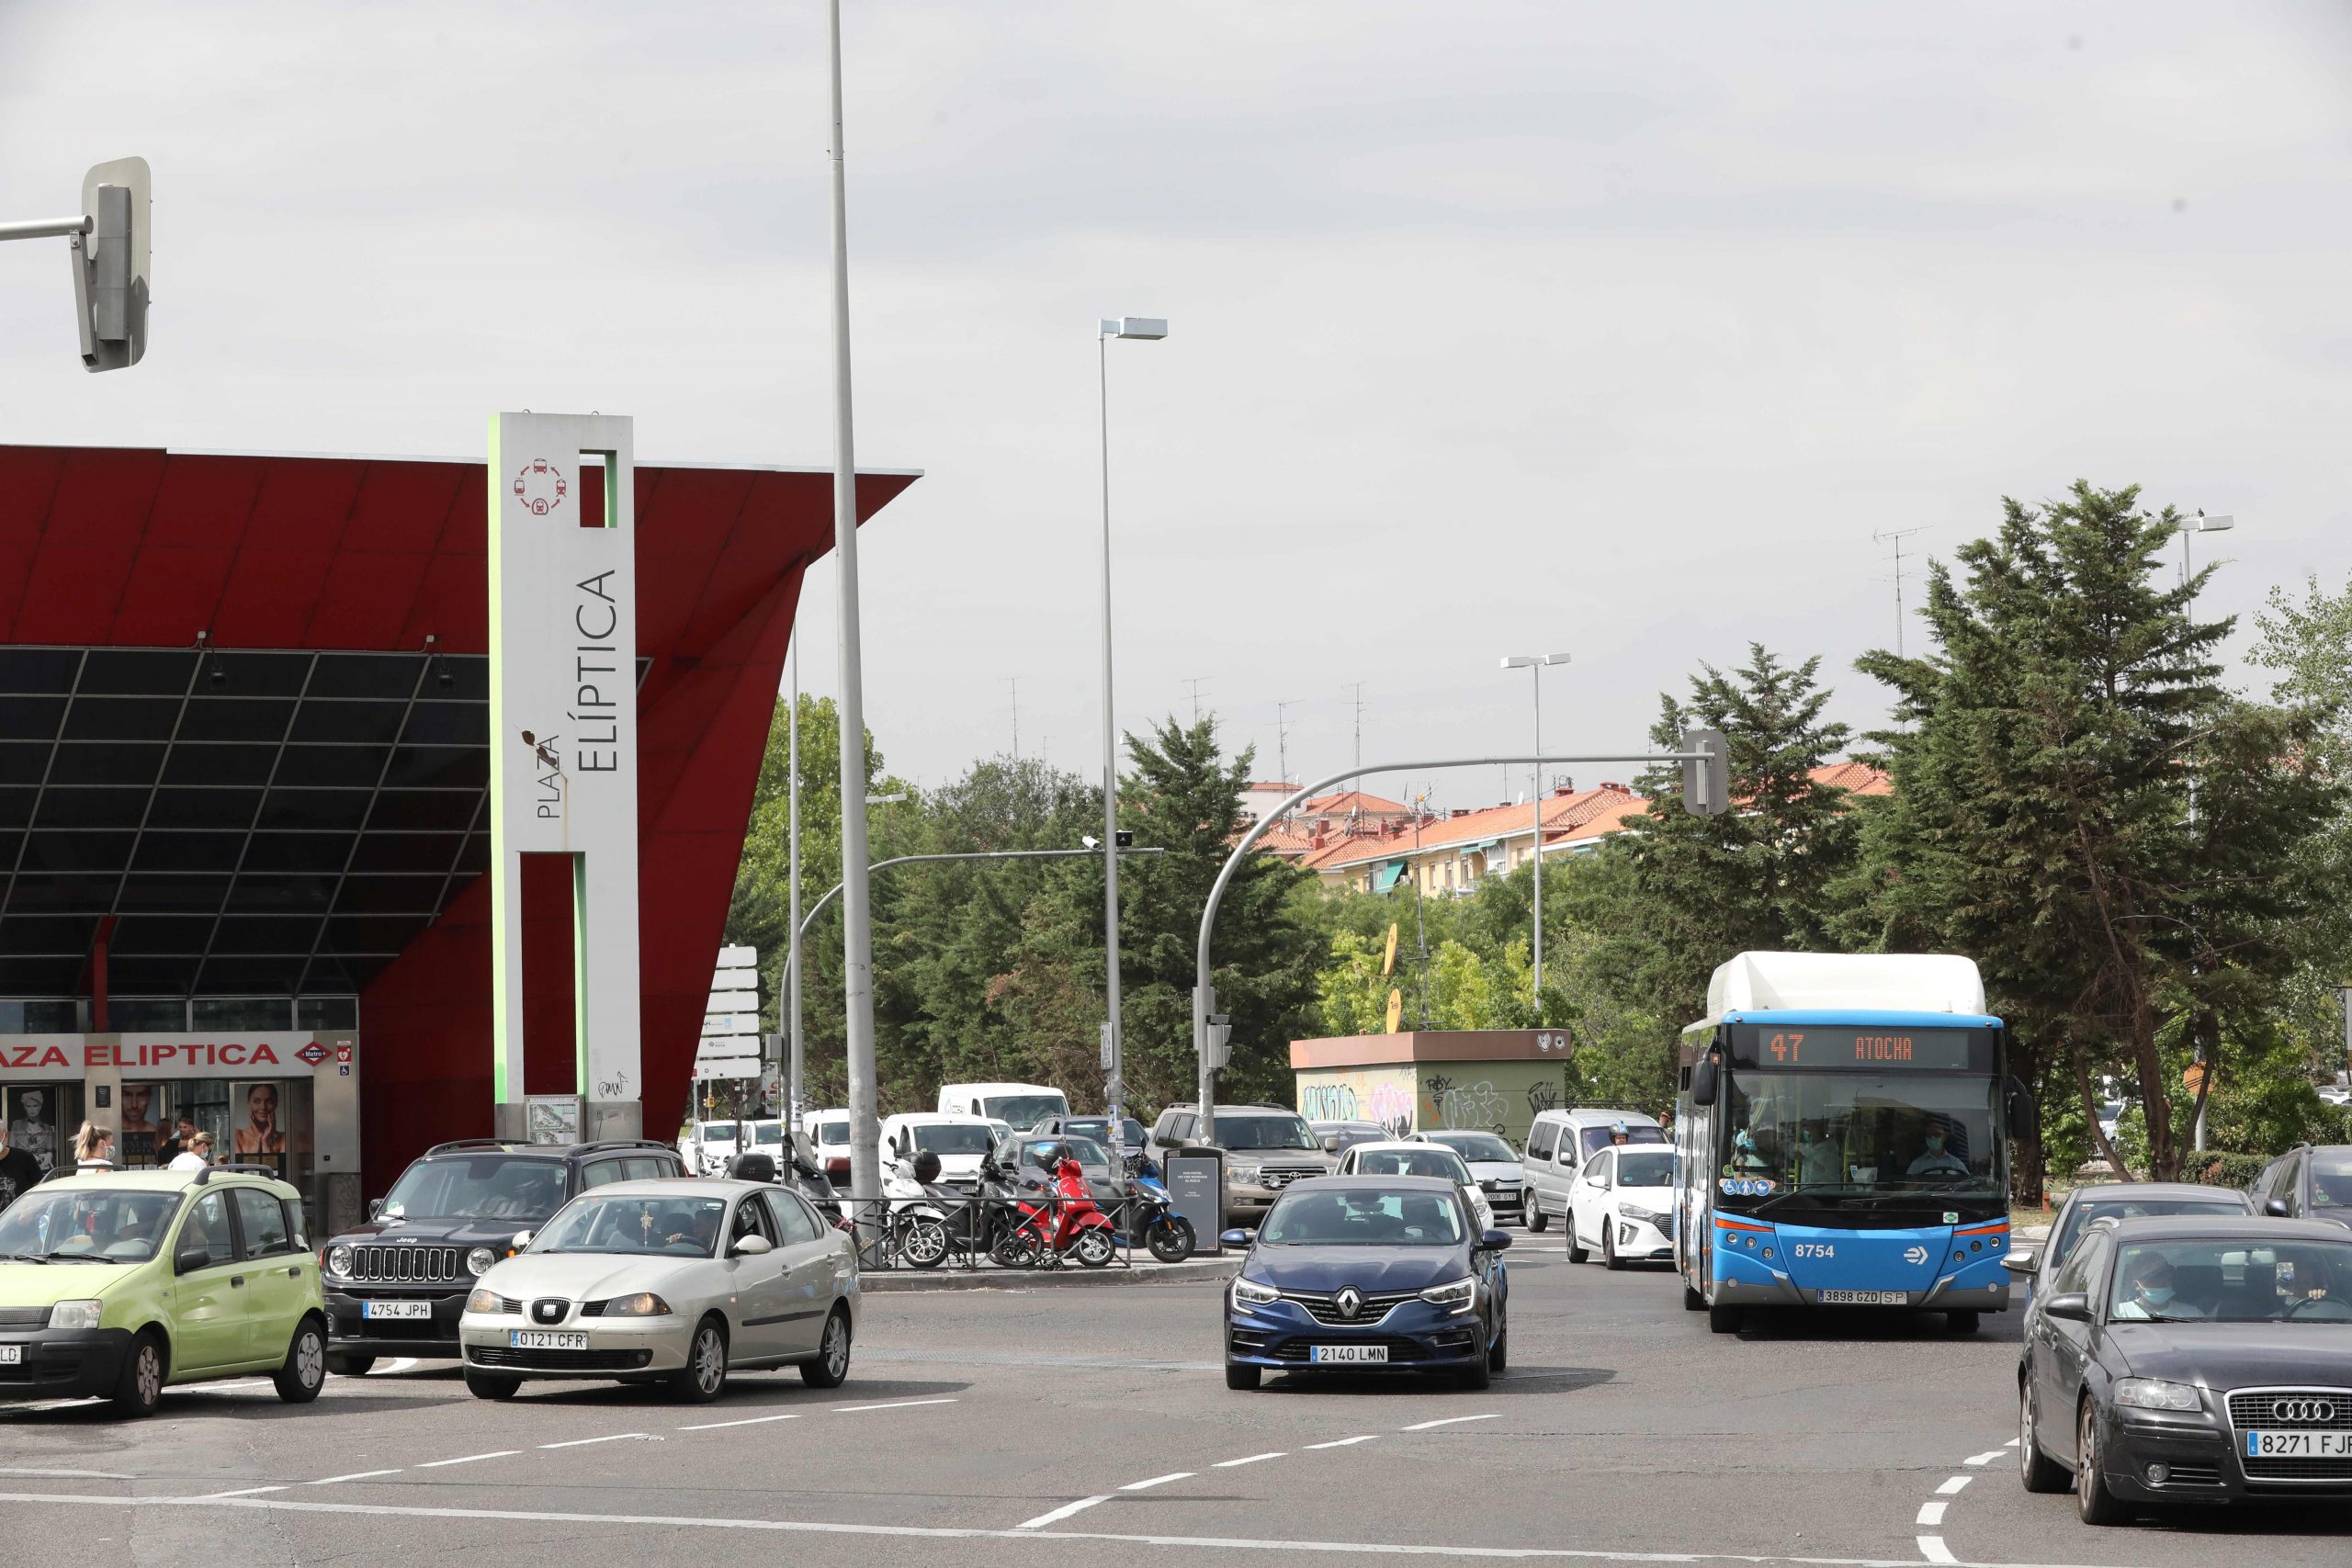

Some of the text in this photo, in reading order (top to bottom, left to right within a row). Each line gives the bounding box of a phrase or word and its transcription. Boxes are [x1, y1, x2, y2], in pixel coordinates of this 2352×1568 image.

[567, 570, 616, 771] ELÍPTICA
[537, 735, 560, 818] PLAZA
[84, 1043, 279, 1066] ELIPTICA
[1770, 1033, 1912, 1061] 47 ATOCHA
[1795, 1245, 1835, 1258] 8754
[1826, 1291, 1853, 1302] 3898
[1857, 1292, 1878, 1303] GZD
[371, 1304, 427, 1316] 4754 JPH
[520, 1333, 583, 1348] 0121 CFR
[0, 1348, 17, 1361] LD
[1320, 1348, 1385, 1360] 2140 LMN
[2262, 1435, 2310, 1453] 8271
